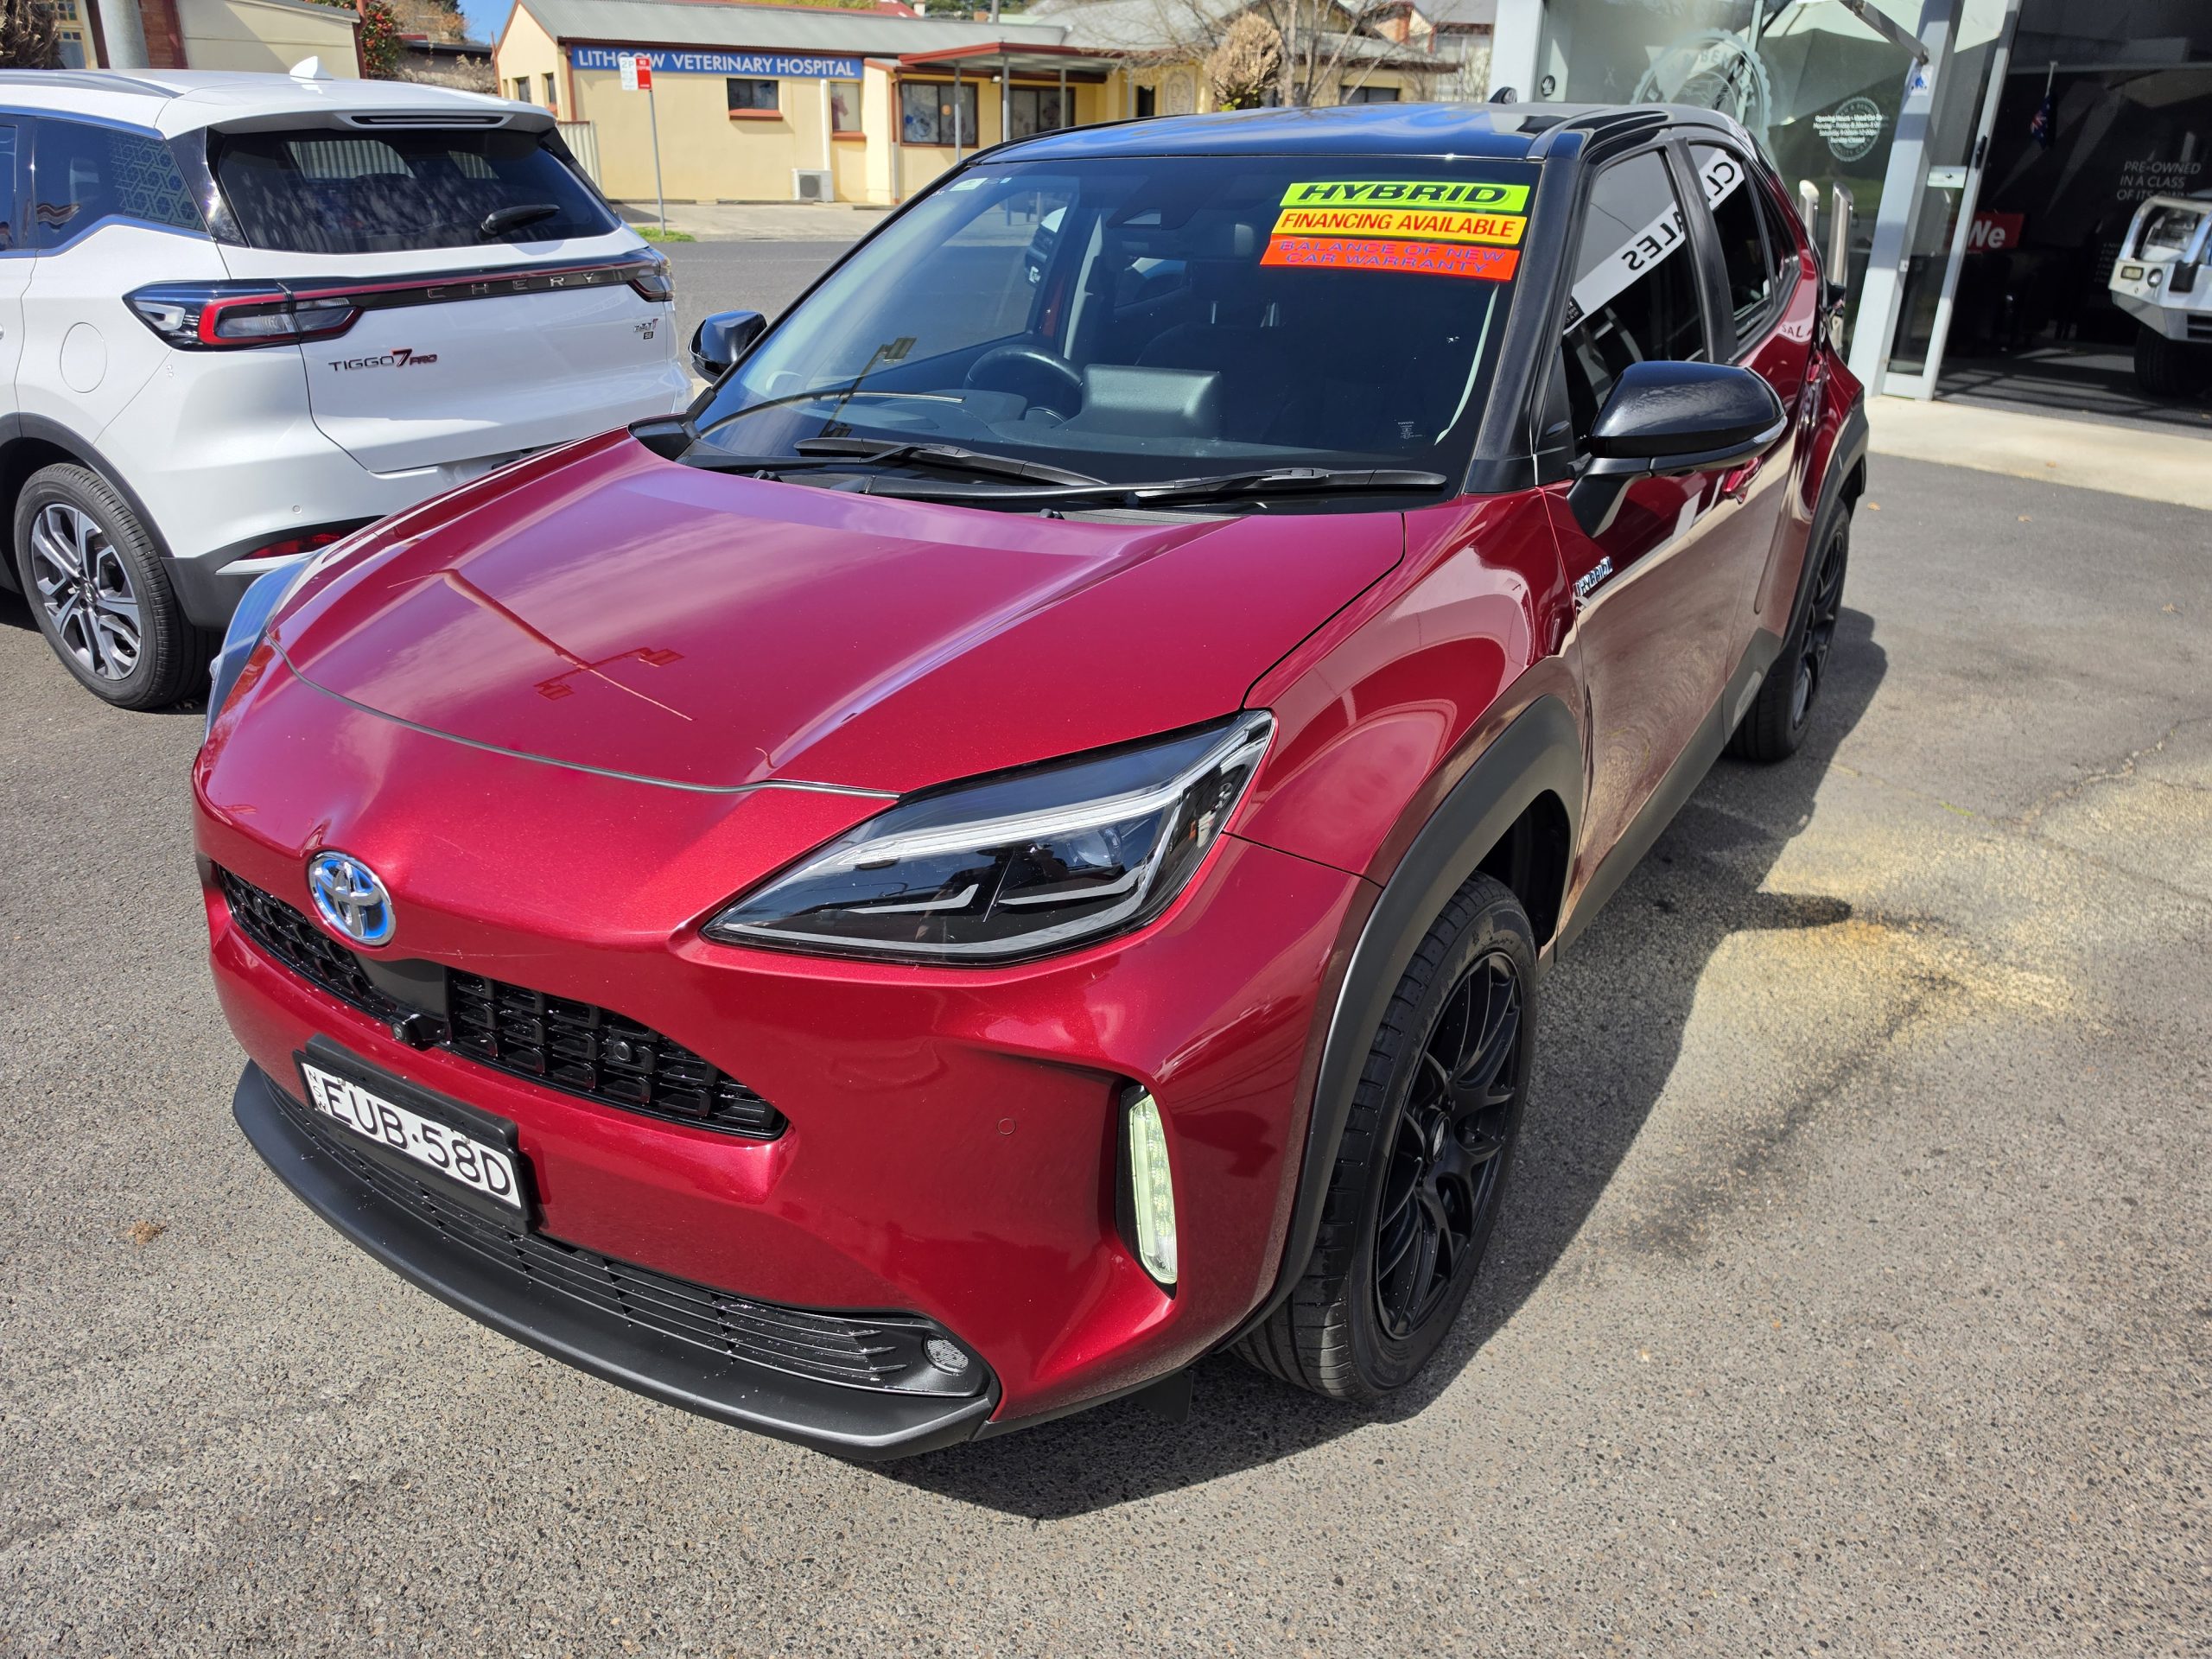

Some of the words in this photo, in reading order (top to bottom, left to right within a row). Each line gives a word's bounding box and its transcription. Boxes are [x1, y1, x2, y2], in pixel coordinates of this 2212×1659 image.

[671, 54, 773, 73] VETERINARY
[777, 58, 855, 76] HOSPITAL
[2124, 160, 2202, 174] PRE-OWNED
[2120, 175, 2133, 186] IN
[2135, 176, 2144, 186] A
[2147, 176, 2186, 188] CLASS
[1297, 183, 1508, 204] HYBRID
[2117, 189, 2134, 200] OF
[1281, 213, 1393, 230] FINANCING
[1396, 216, 1516, 238] AVAILABLE
[1279, 241, 1396, 255] BALANCE
[1404, 245, 1440, 257] OF
[1446, 248, 1506, 261] NEW
[1285, 252, 1337, 264] CAR
[1345, 255, 1489, 273] WARRANTY
[427, 272, 595, 299] CHERY
[328, 355, 395, 372] TIGGO
[308, 1070, 329, 1113] NSW
